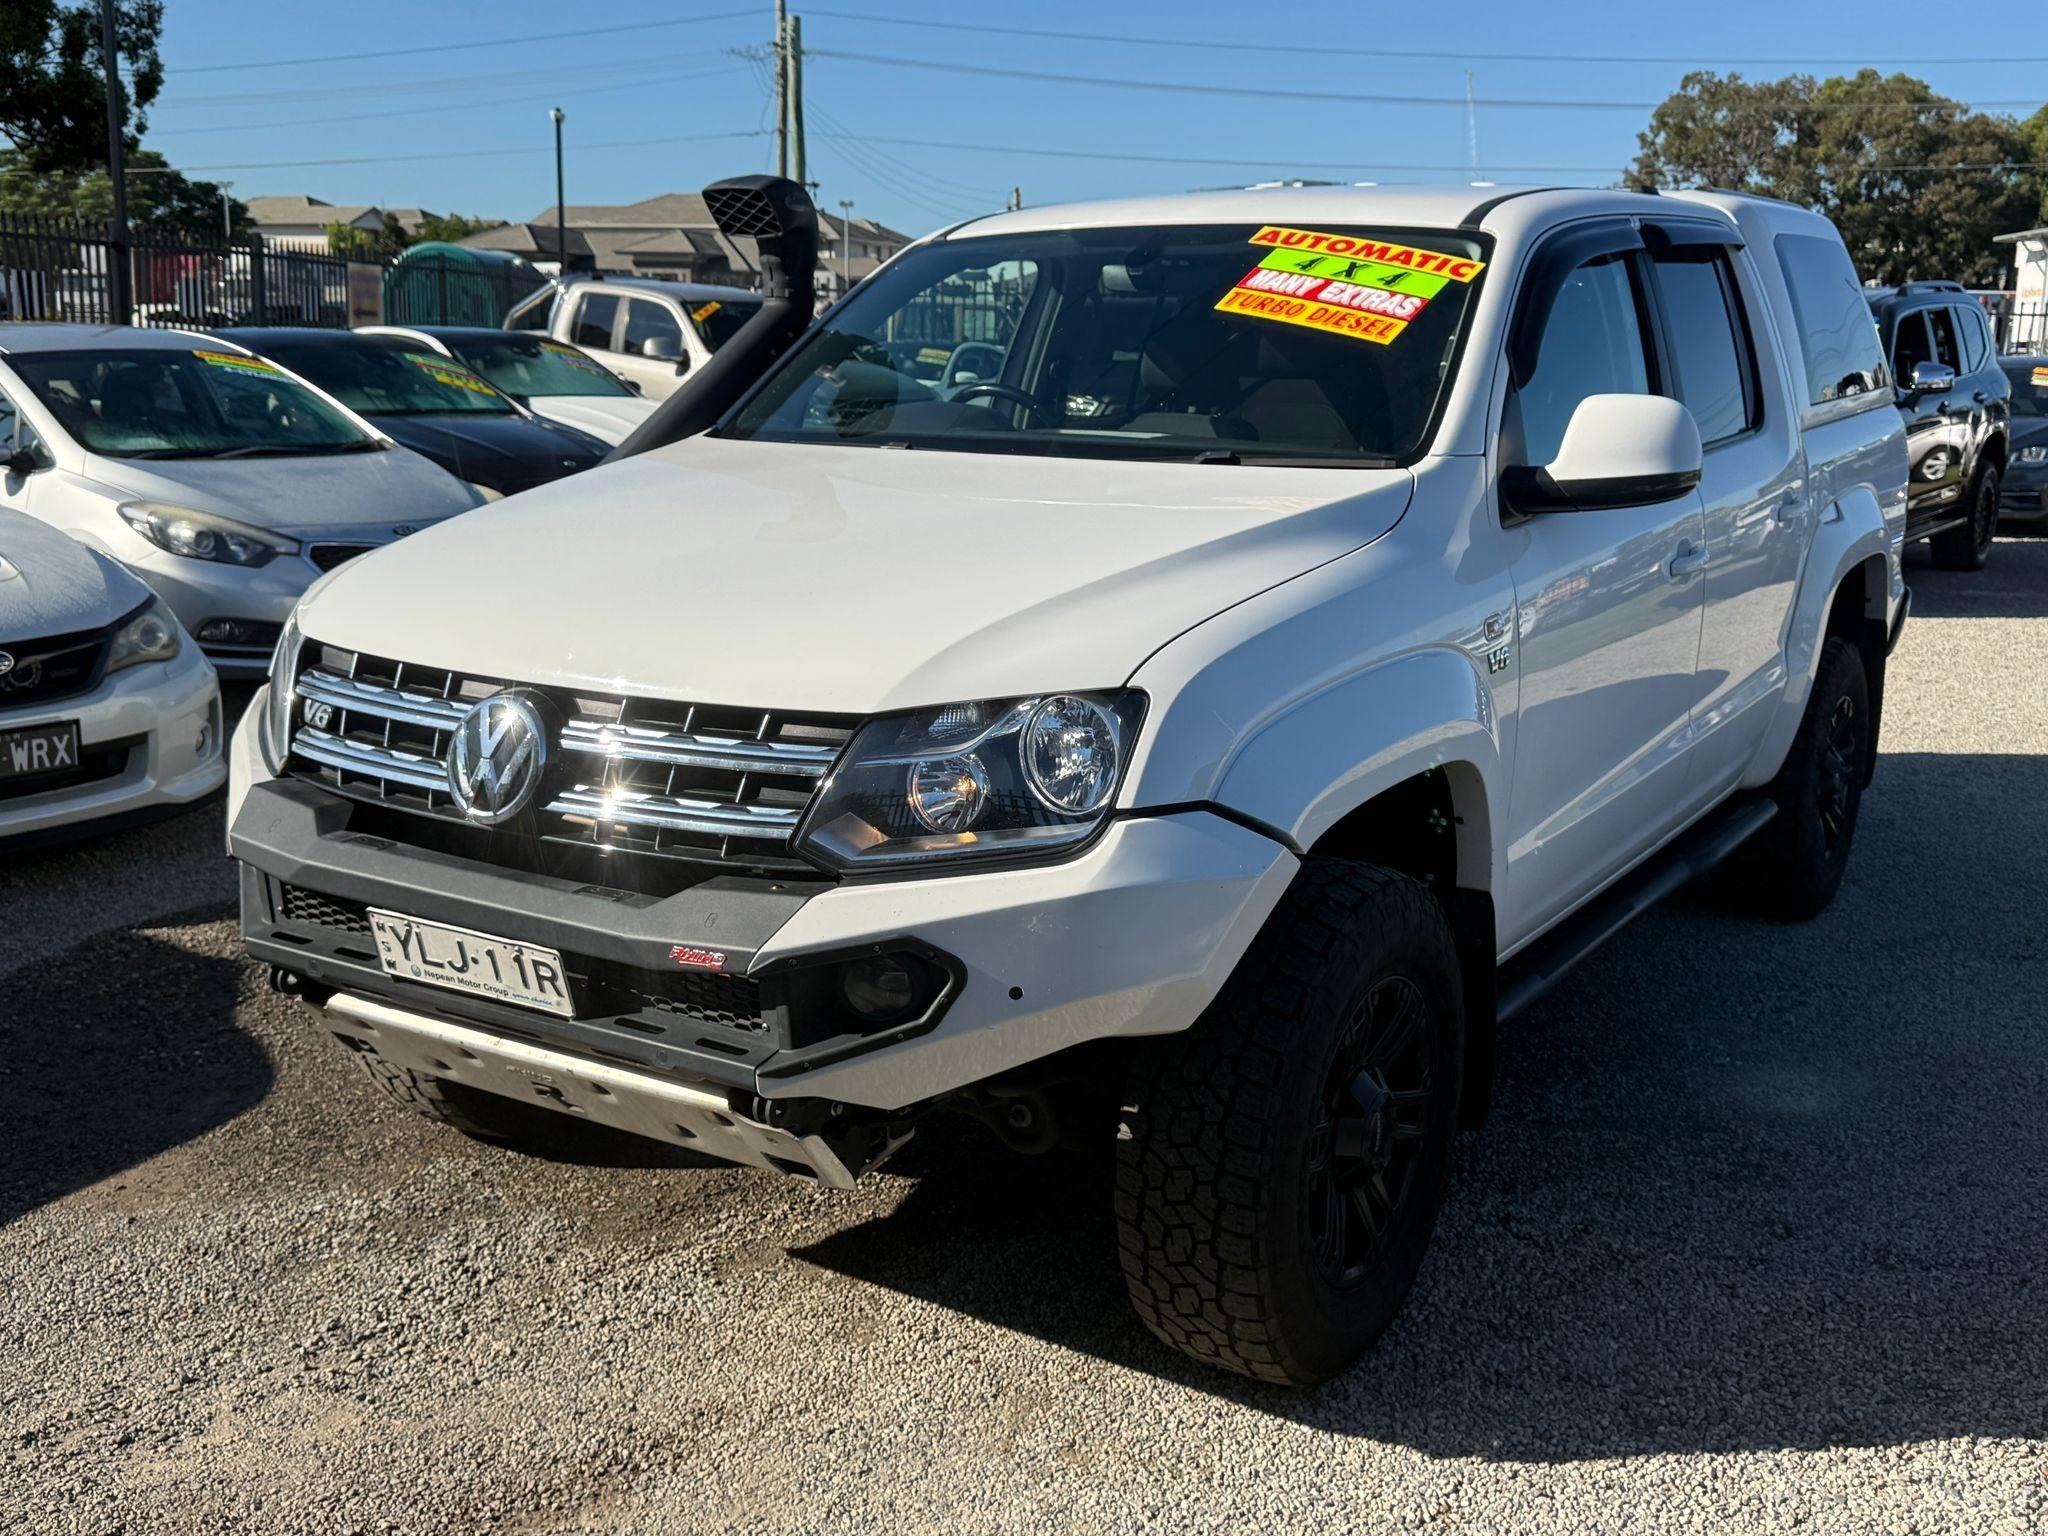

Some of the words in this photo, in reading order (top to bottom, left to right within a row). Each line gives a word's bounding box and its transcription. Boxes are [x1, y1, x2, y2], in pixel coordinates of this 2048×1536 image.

[1256, 229, 1474, 278] AUTOMATIC
[1225, 291, 1307, 318] TURBO
[1308, 307, 1398, 339] DIESEL
[1246, 269, 1320, 297] MANY
[1318, 281, 1423, 316] EXTRAS
[303, 697, 334, 729] V6
[424, 968, 456, 983] Nepean
[457, 976, 481, 989] Motor
[483, 983, 509, 997] Group
